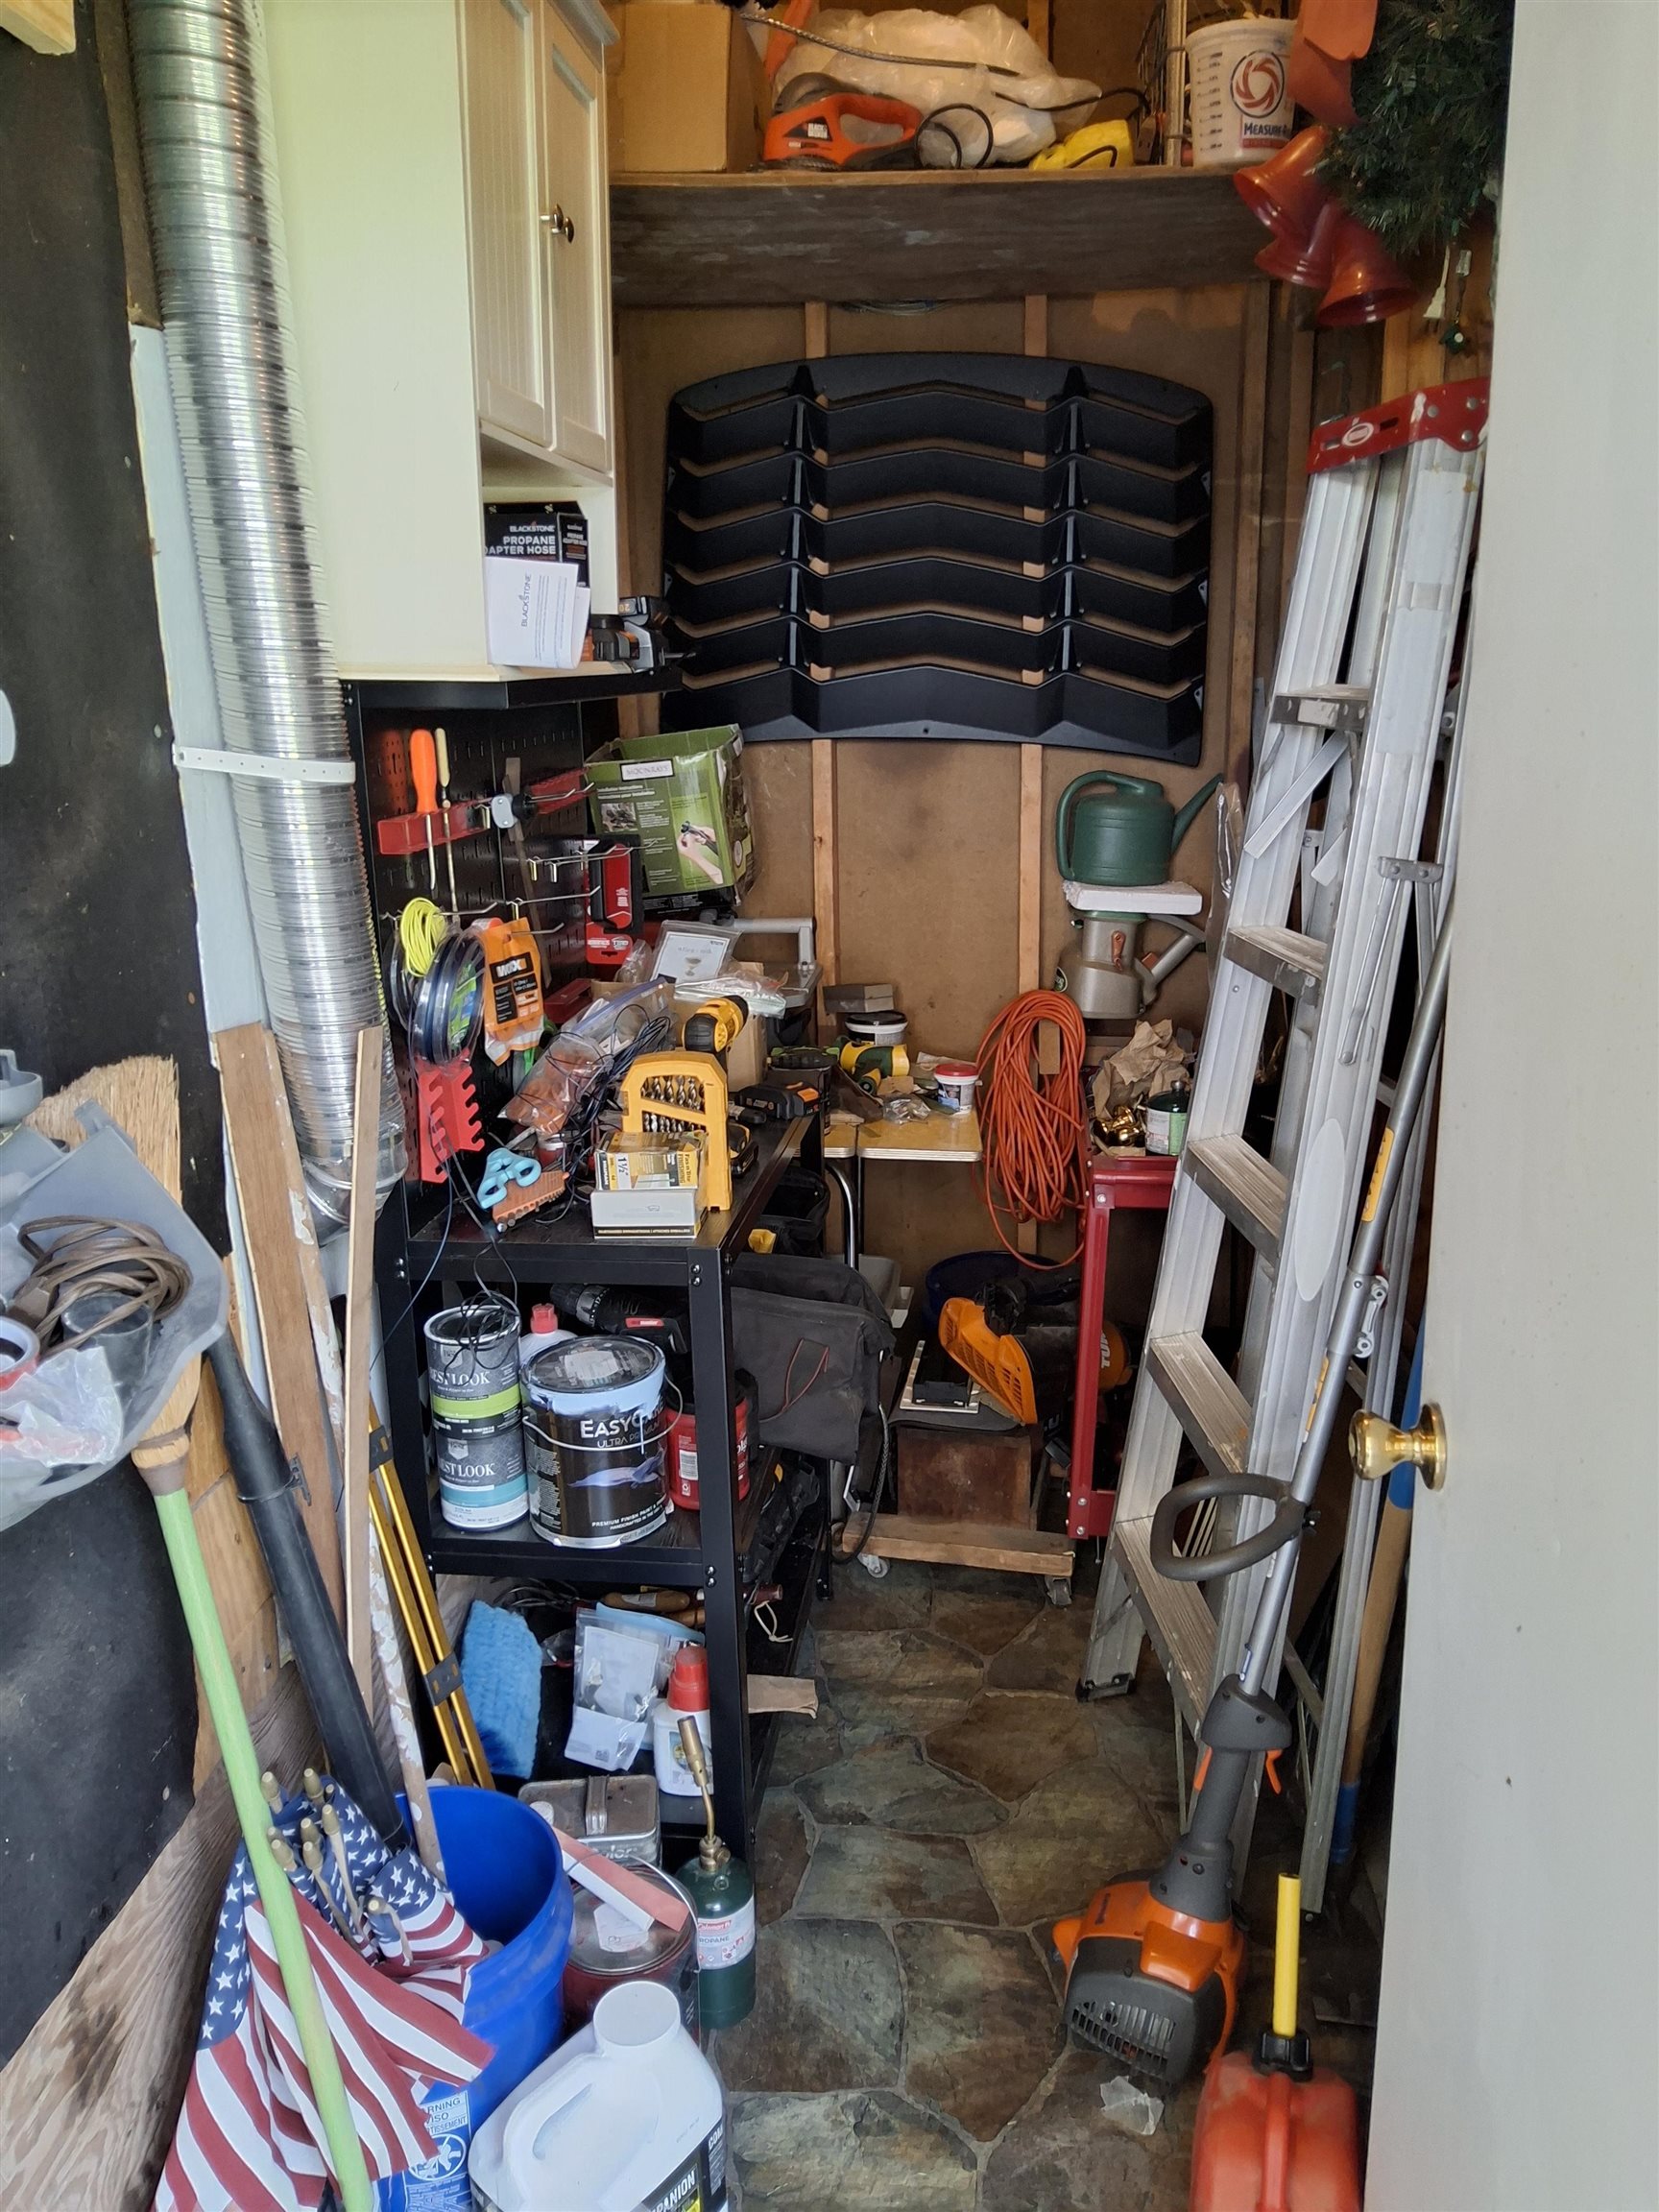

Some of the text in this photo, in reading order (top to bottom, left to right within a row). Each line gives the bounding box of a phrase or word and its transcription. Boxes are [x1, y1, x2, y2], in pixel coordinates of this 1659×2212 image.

[503, 536, 556, 545] PROPANE
[484, 545, 525, 555] DAPTER
[597, 1436, 629, 1449] ULTRA
[458, 1462, 496, 1478] LOOK
[591, 1518, 620, 1527] PREMIUM
[426, 2097, 461, 2113] RNING
